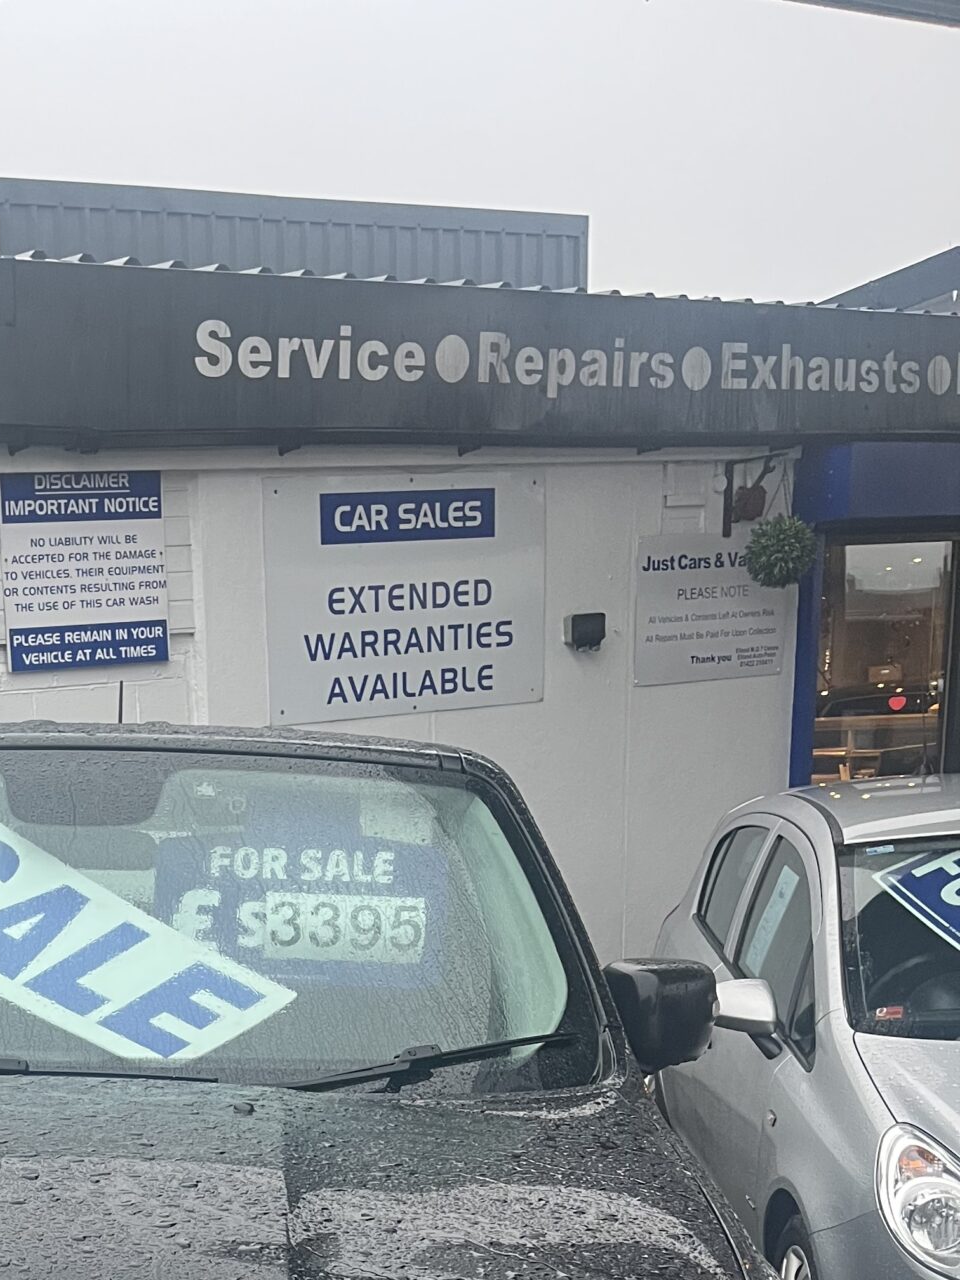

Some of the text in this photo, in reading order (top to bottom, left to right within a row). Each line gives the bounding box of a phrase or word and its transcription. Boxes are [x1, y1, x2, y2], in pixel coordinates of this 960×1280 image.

[194, 319, 920, 399] Service Repairs Exhausts
[34, 473, 129, 490] DISCLAIMER
[5, 497, 159, 516] IMPORTANT NOTICE
[334, 500, 482, 532] CAR SALES
[30, 534, 138, 547] NO LIABILITY WILL BE
[11, 550, 156, 564] ACCEPTED FOR THE DAMAGE
[642, 552, 748, 572] Just Cars & Va
[4, 571, 18, 581] TO
[75, 567, 104, 578] THEIR
[107, 564, 164, 576] EQUIPMENT
[3, 580, 167, 597] OR CONTENTS RESULTING FROM
[327, 578, 492, 615] EXTENDED
[677, 584, 749, 600] PLEASE NOTE
[14, 596, 159, 613] THE USE OF THIS CAR WASH
[13, 626, 163, 647] PLEASE REMAIN IN YOUR
[303, 620, 513, 662] WARRANTIES
[22, 645, 156, 665] VEHICLE AT ALL TIMES
[690, 654, 716, 664] Thank
[717, 655, 732, 664] you
[326, 664, 493, 705] AVAILABLE
[210, 846, 395, 884] FOR SALE
